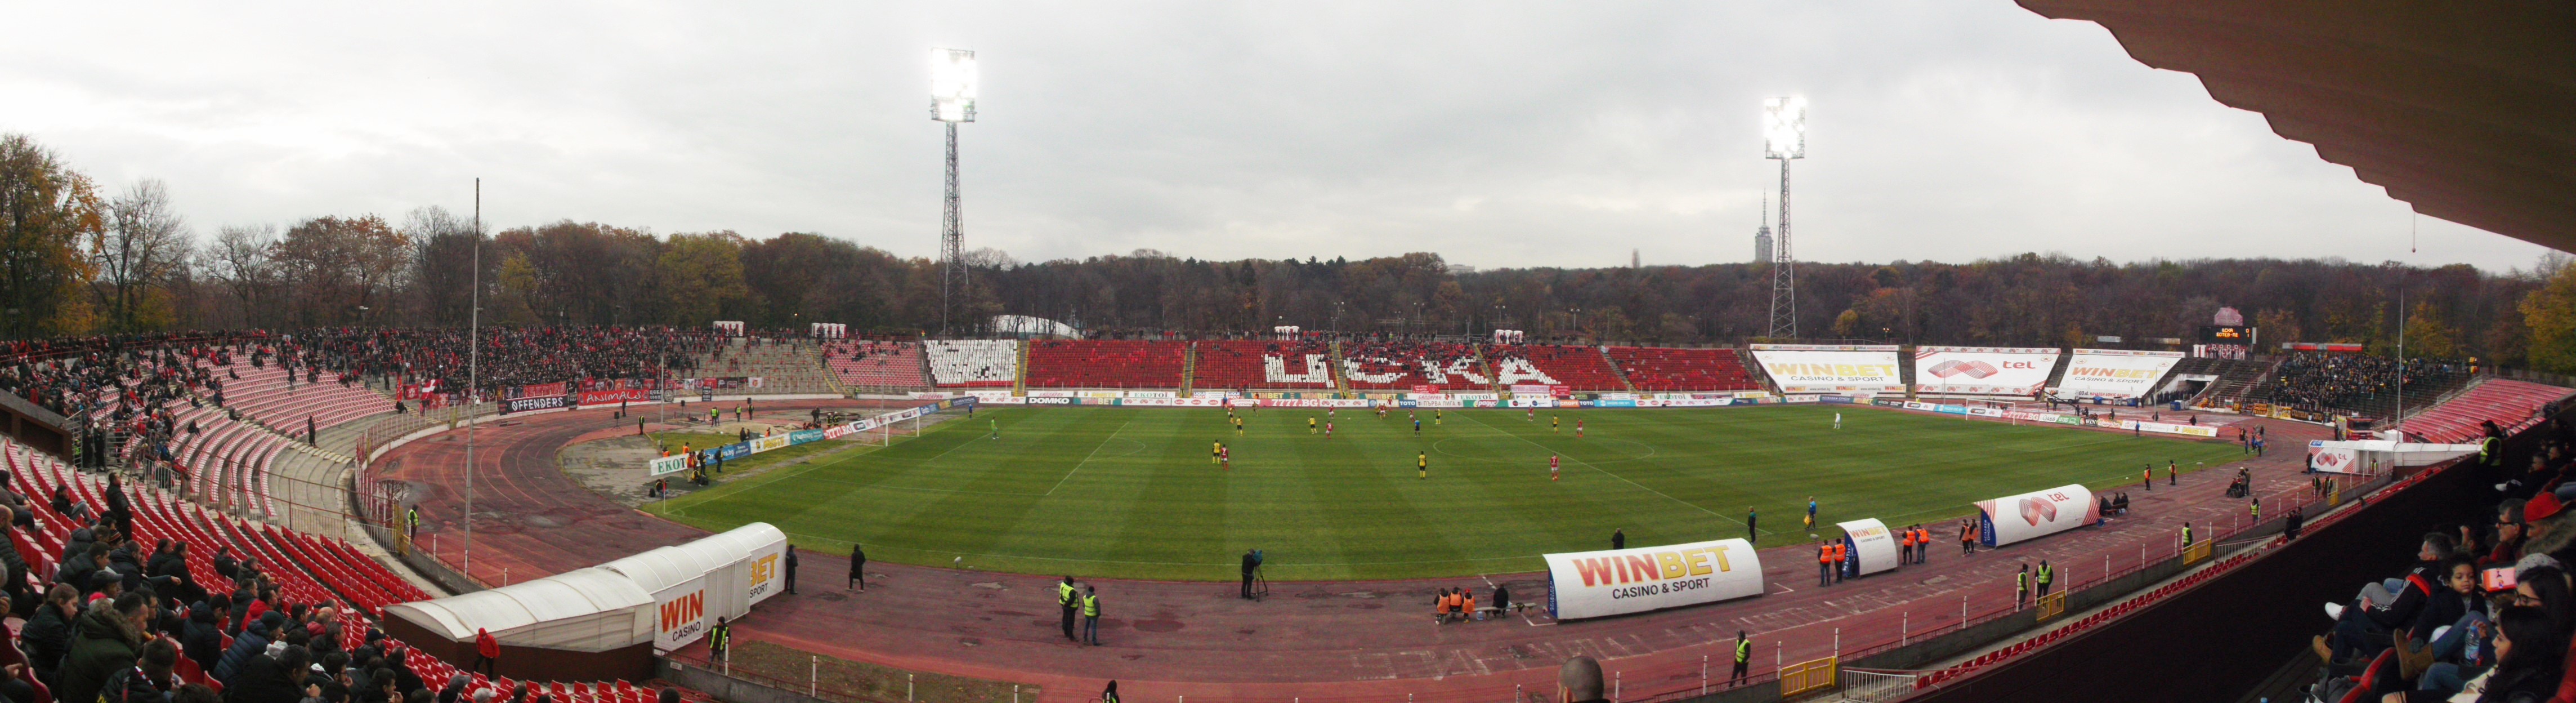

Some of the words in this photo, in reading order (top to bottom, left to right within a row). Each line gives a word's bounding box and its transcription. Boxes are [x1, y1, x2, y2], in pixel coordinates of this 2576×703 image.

[1768, 363, 1895, 376] WINBET
[2002, 361, 2036, 369] tel
[2072, 367, 2161, 379] WINBET
[511, 398, 564, 411] OFFENDERS
[587, 391, 642, 404] ANIMALS
[658, 458, 686, 474] EKOT
[2047, 492, 2070, 502] tel
[1849, 526, 1887, 539] WINBET
[750, 552, 778, 587] BET
[1572, 545, 1730, 588] WINBET
[750, 583, 768, 598] SPORT
[1612, 585, 1658, 599] CASINO
[1662, 584, 1670, 593] &
[1672, 577, 1710, 592] SPORT
[660, 588, 705, 634] WIN
[672, 621, 701, 642] CASINO
